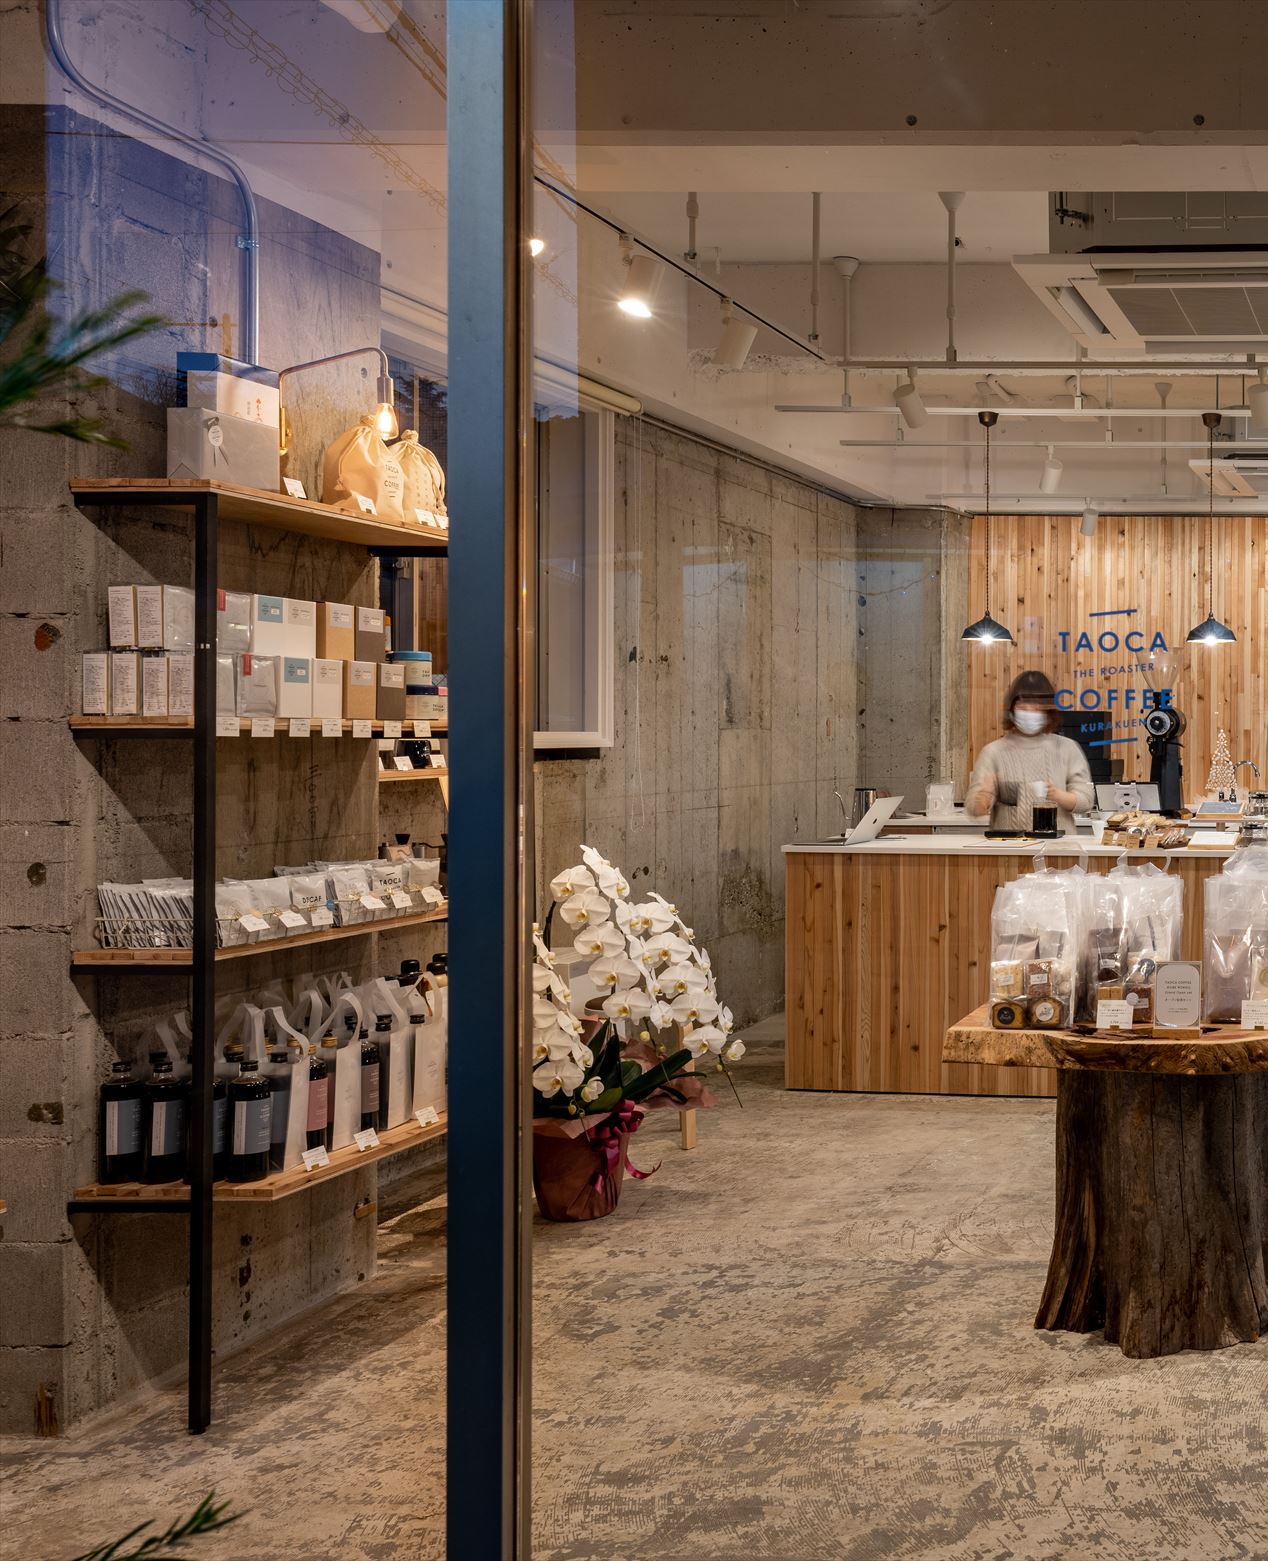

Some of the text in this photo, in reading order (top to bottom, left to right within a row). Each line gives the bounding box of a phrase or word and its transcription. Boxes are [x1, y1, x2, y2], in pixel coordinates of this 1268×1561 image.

[1058, 631, 1169, 653] TAOCA
[1073, 663, 1155, 679] THE ROASTER
[1054, 688, 1174, 711] COFFEE
[1080, 718, 1147, 733] KURAKUEN
